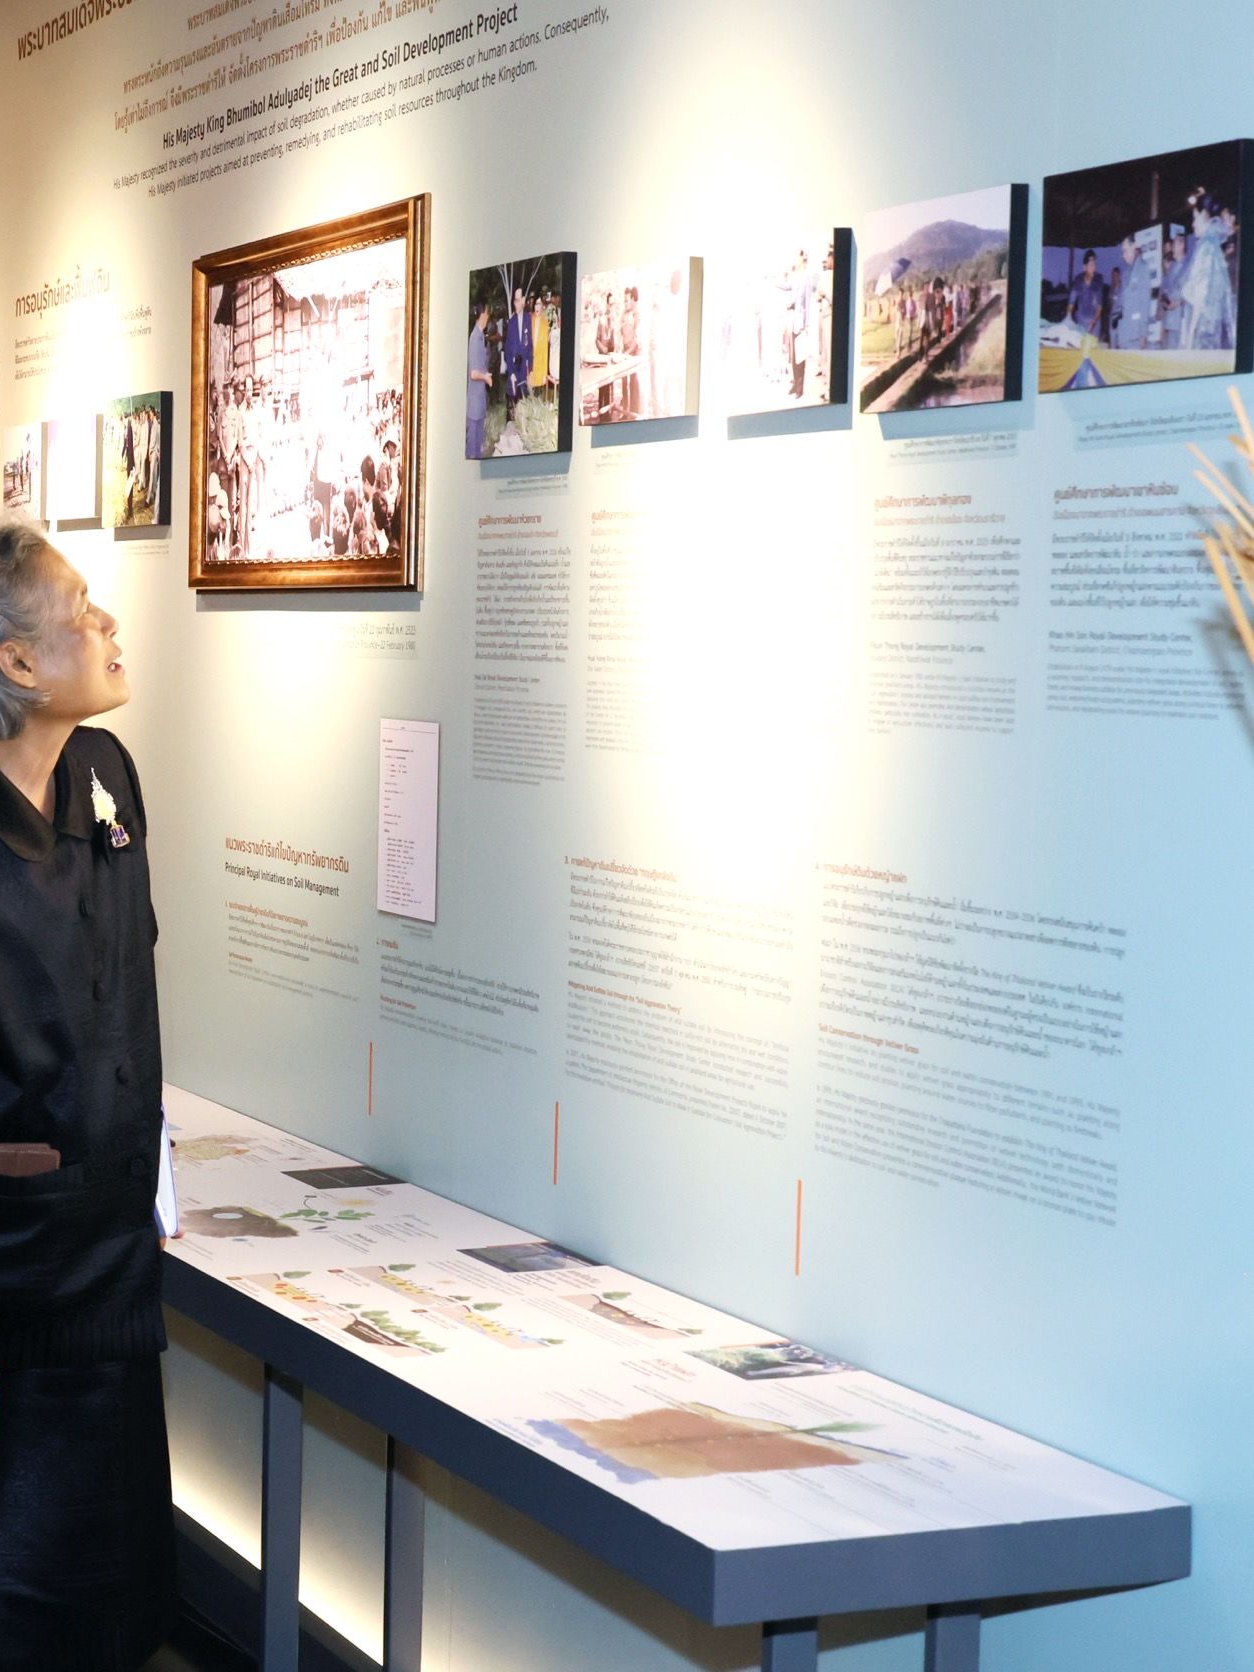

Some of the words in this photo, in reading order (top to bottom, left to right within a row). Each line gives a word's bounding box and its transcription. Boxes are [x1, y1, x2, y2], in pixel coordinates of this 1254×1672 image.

[121, 173, 139, 188] Majesty
[140, 162, 167, 180] recognized
[168, 158, 177, 170] the
[178, 151, 198, 167] severity
[200, 145, 211, 160] and
[211, 134, 245, 155] detrimental
[246, 126, 268, 144] impact
[268, 120, 276, 136] of
[277, 117, 288, 133] soil
[289, 102, 330, 130] degradation,
[331, 95, 359, 114] whether
[361, 85, 386, 105] caused
[387, 82, 397, 98] by
[398, 72, 425, 91] natural
[427, 58, 465, 82] processes
[466, 53, 475, 67] or
[477, 43, 507, 63] human
[509, 31, 541, 53] actions.
[544, 5, 609, 40] Consequently,
[157, 180, 176, 196] Majesty
[177, 171, 199, 188] initiated
[200, 164, 222, 181] projects
[223, 156, 241, 173] aimed
[242, 154, 249, 167] at
[322, 123, 337, 141] and
[337, 110, 383, 135] rehabilitating
[384, 104, 396, 121] soil
[398, 94, 433, 115] resources
[435, 78, 479, 103] throughout
[482, 72, 496, 88] the
[498, 59, 538, 84] Kingdom.
[163, 133, 175, 150] His
[175, 122, 204, 146] Majesty
[206, 114, 224, 133] King
[226, 96, 265, 126] Bhumibol
[269, 78, 312, 110] Adulyadej
[314, 74, 330, 95] the
[332, 65, 358, 88] Great
[361, 53, 379, 78] and
[381, 45, 400, 71] Soil
[403, 19, 473, 62] Development
[476, 3, 518, 35] Project
[225, 862, 246, 877] Principal
[246, 866, 261, 881] Royal
[261, 870, 286, 885] Initiatives
[286, 877, 294, 886] on
[294, 876, 304, 889] Soil
[305, 878, 339, 897] Management
